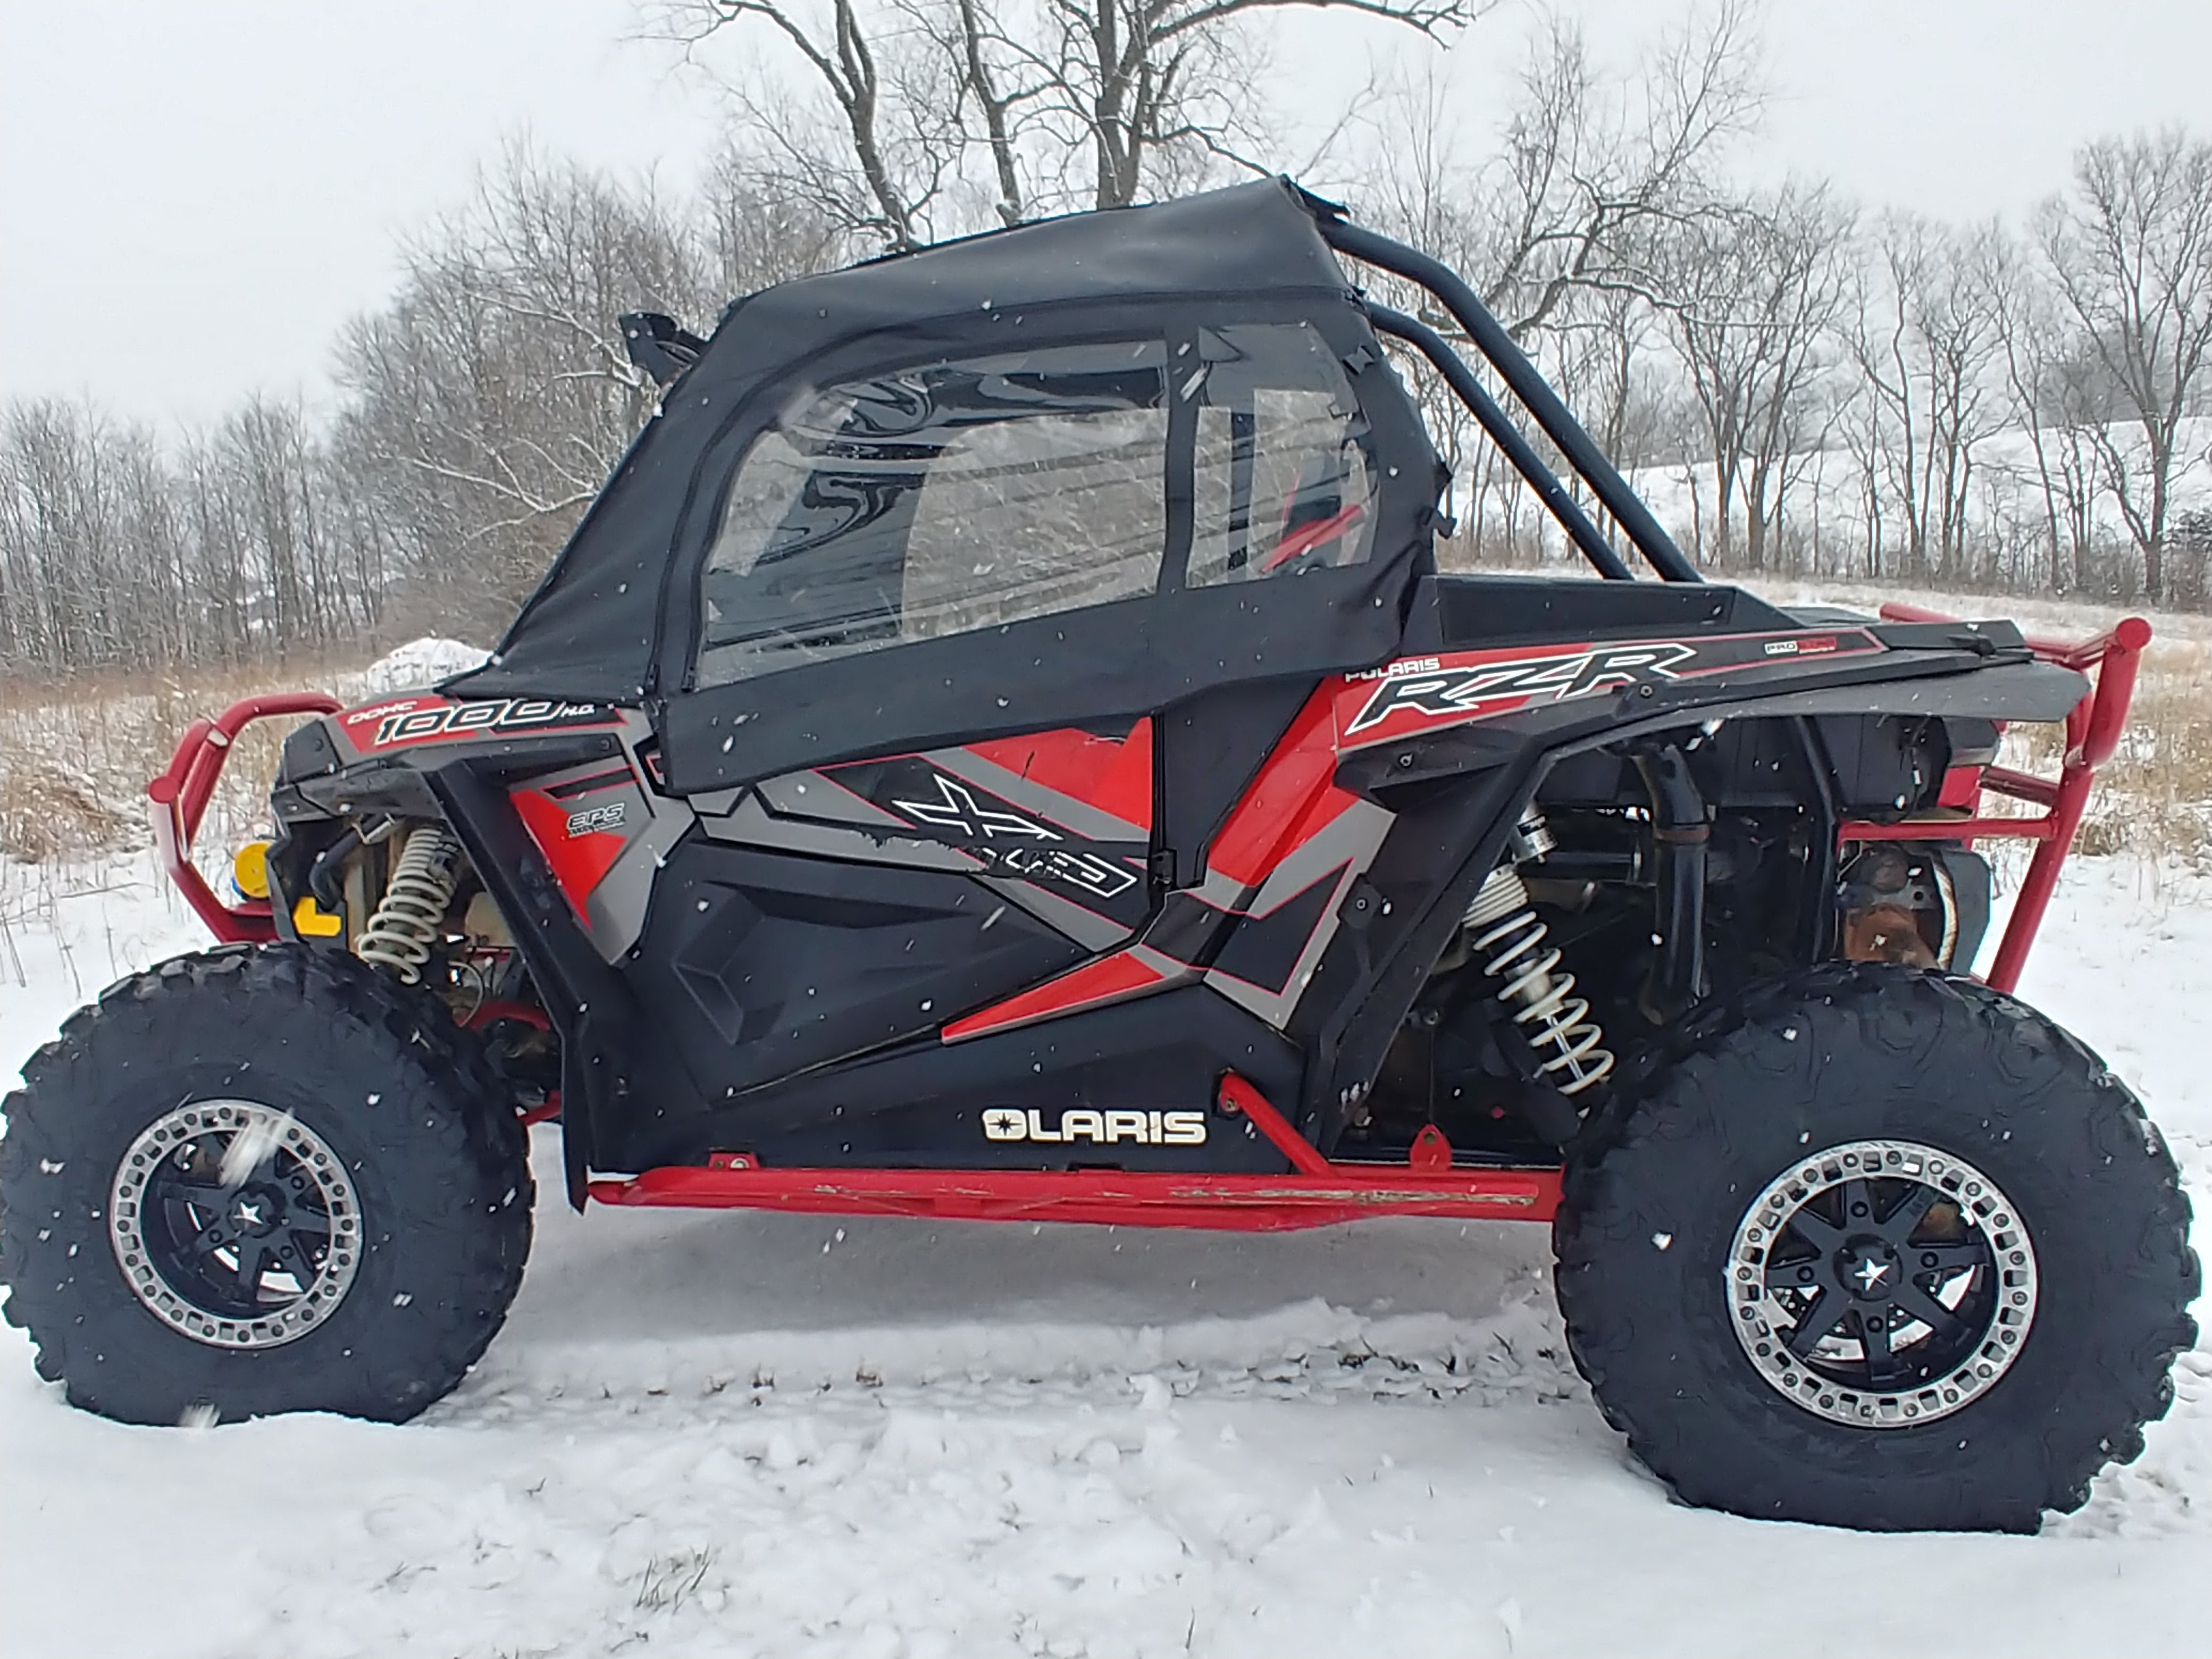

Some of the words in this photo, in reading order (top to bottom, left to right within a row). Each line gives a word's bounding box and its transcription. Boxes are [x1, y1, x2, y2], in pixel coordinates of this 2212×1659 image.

[1345, 643, 1697, 736] RZR
[347, 701, 417, 725] DOHC
[374, 698, 566, 745] 1000
[566, 802, 625, 830] EPS
